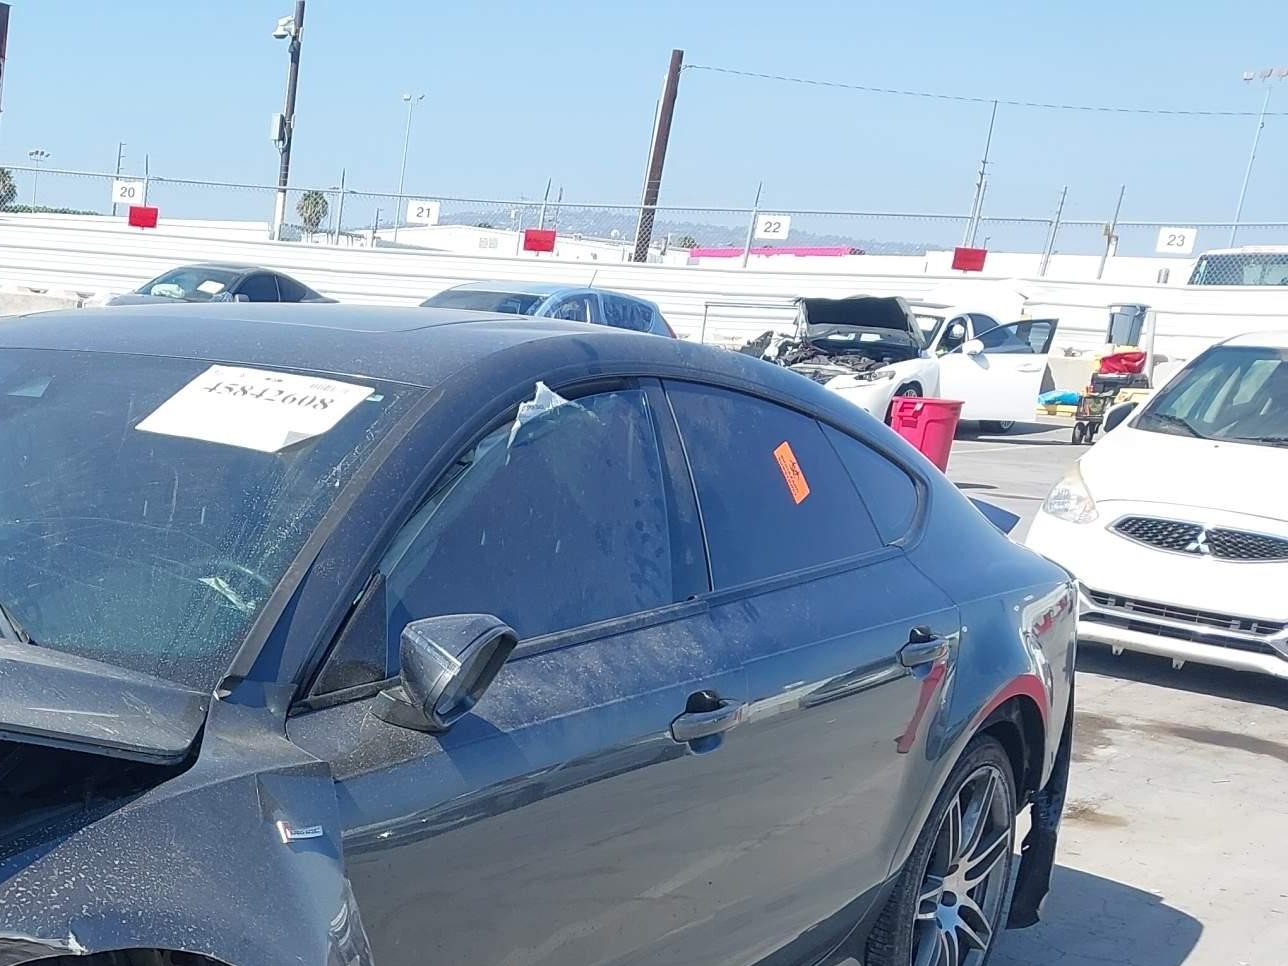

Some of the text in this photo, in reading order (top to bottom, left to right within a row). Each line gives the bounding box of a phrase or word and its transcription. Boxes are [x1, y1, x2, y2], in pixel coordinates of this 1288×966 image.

[119, 186, 135, 198] 20
[416, 206, 431, 218] 21
[763, 221, 782, 233] 22
[1167, 234, 1186, 247] 23
[201, 381, 334, 410] 45842608
